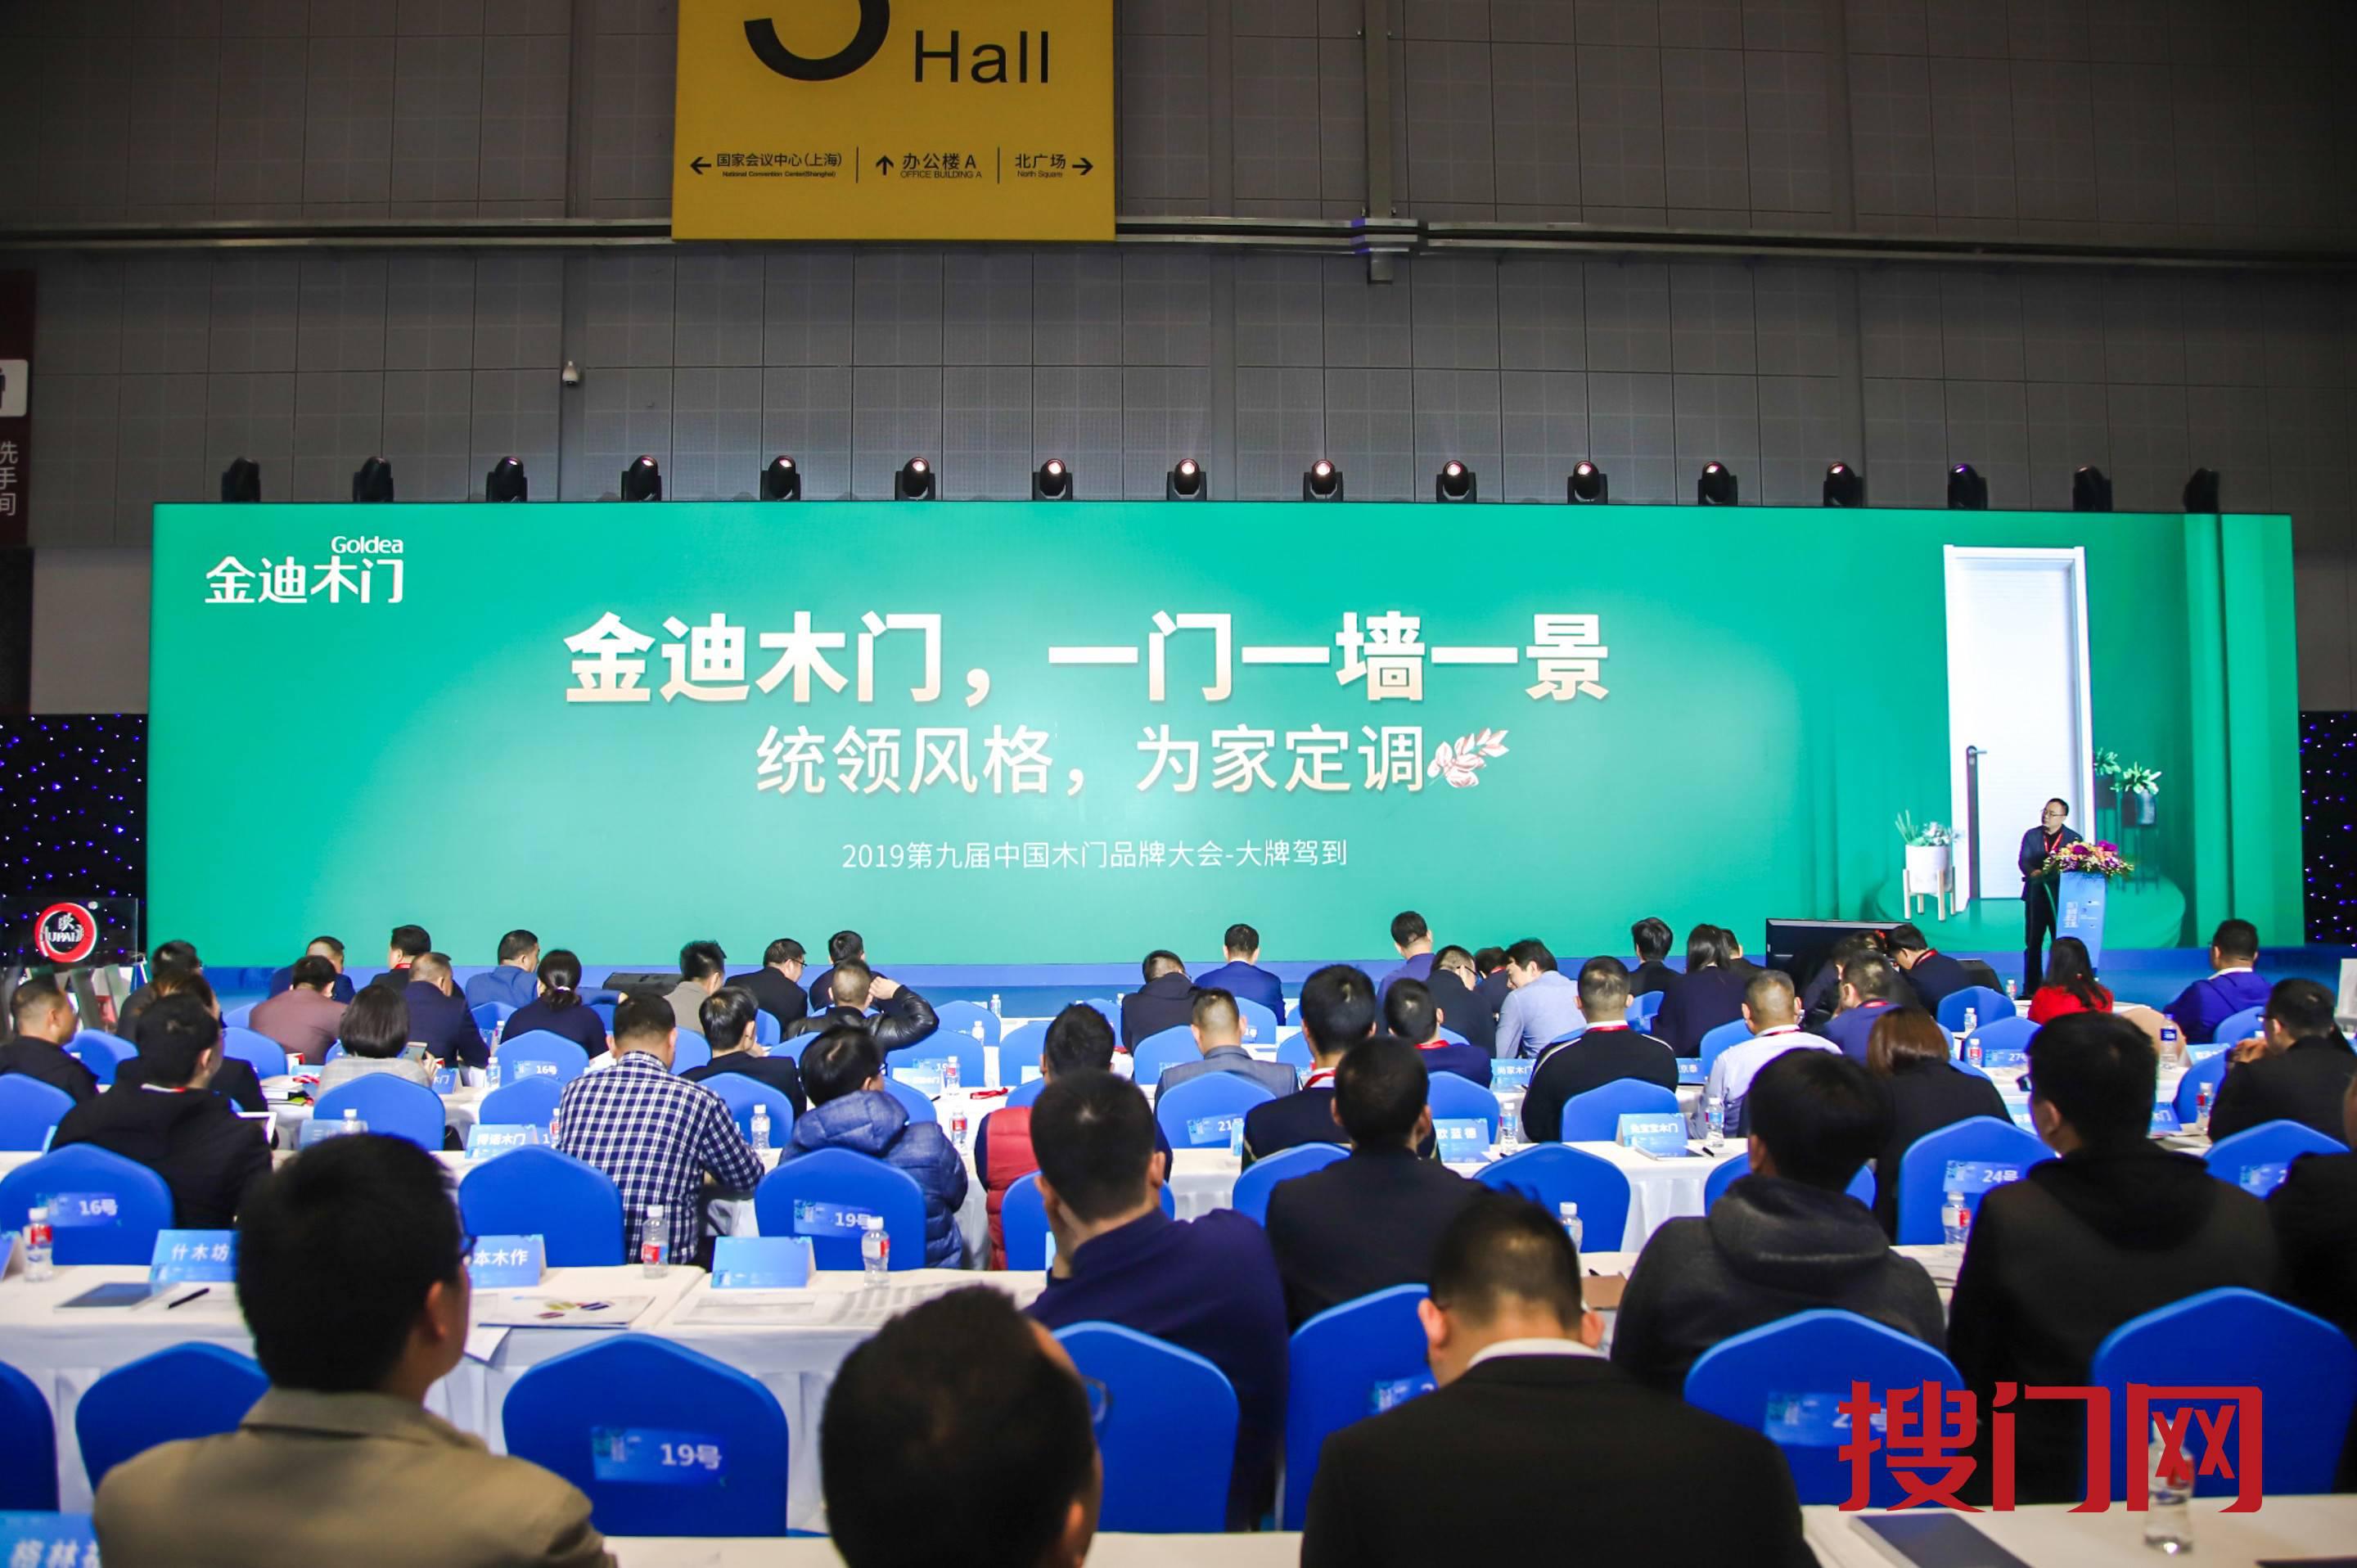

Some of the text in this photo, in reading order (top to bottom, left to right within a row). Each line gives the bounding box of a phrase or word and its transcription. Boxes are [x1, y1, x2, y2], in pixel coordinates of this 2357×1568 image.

[914, 29, 1049, 83] Hall
[1015, 154, 1066, 169] 北广场
[900, 170, 982, 178] OFFICE BUILDING A
[1038, 170, 1063, 179] Square
[331, 536, 403, 554] Goldea
[205, 556, 403, 603] 金迪木门
[842, 839, 1348, 870] 2019第九届中国木门品牌大会-大牌驾到
[660, 1443, 722, 1470] 19号
